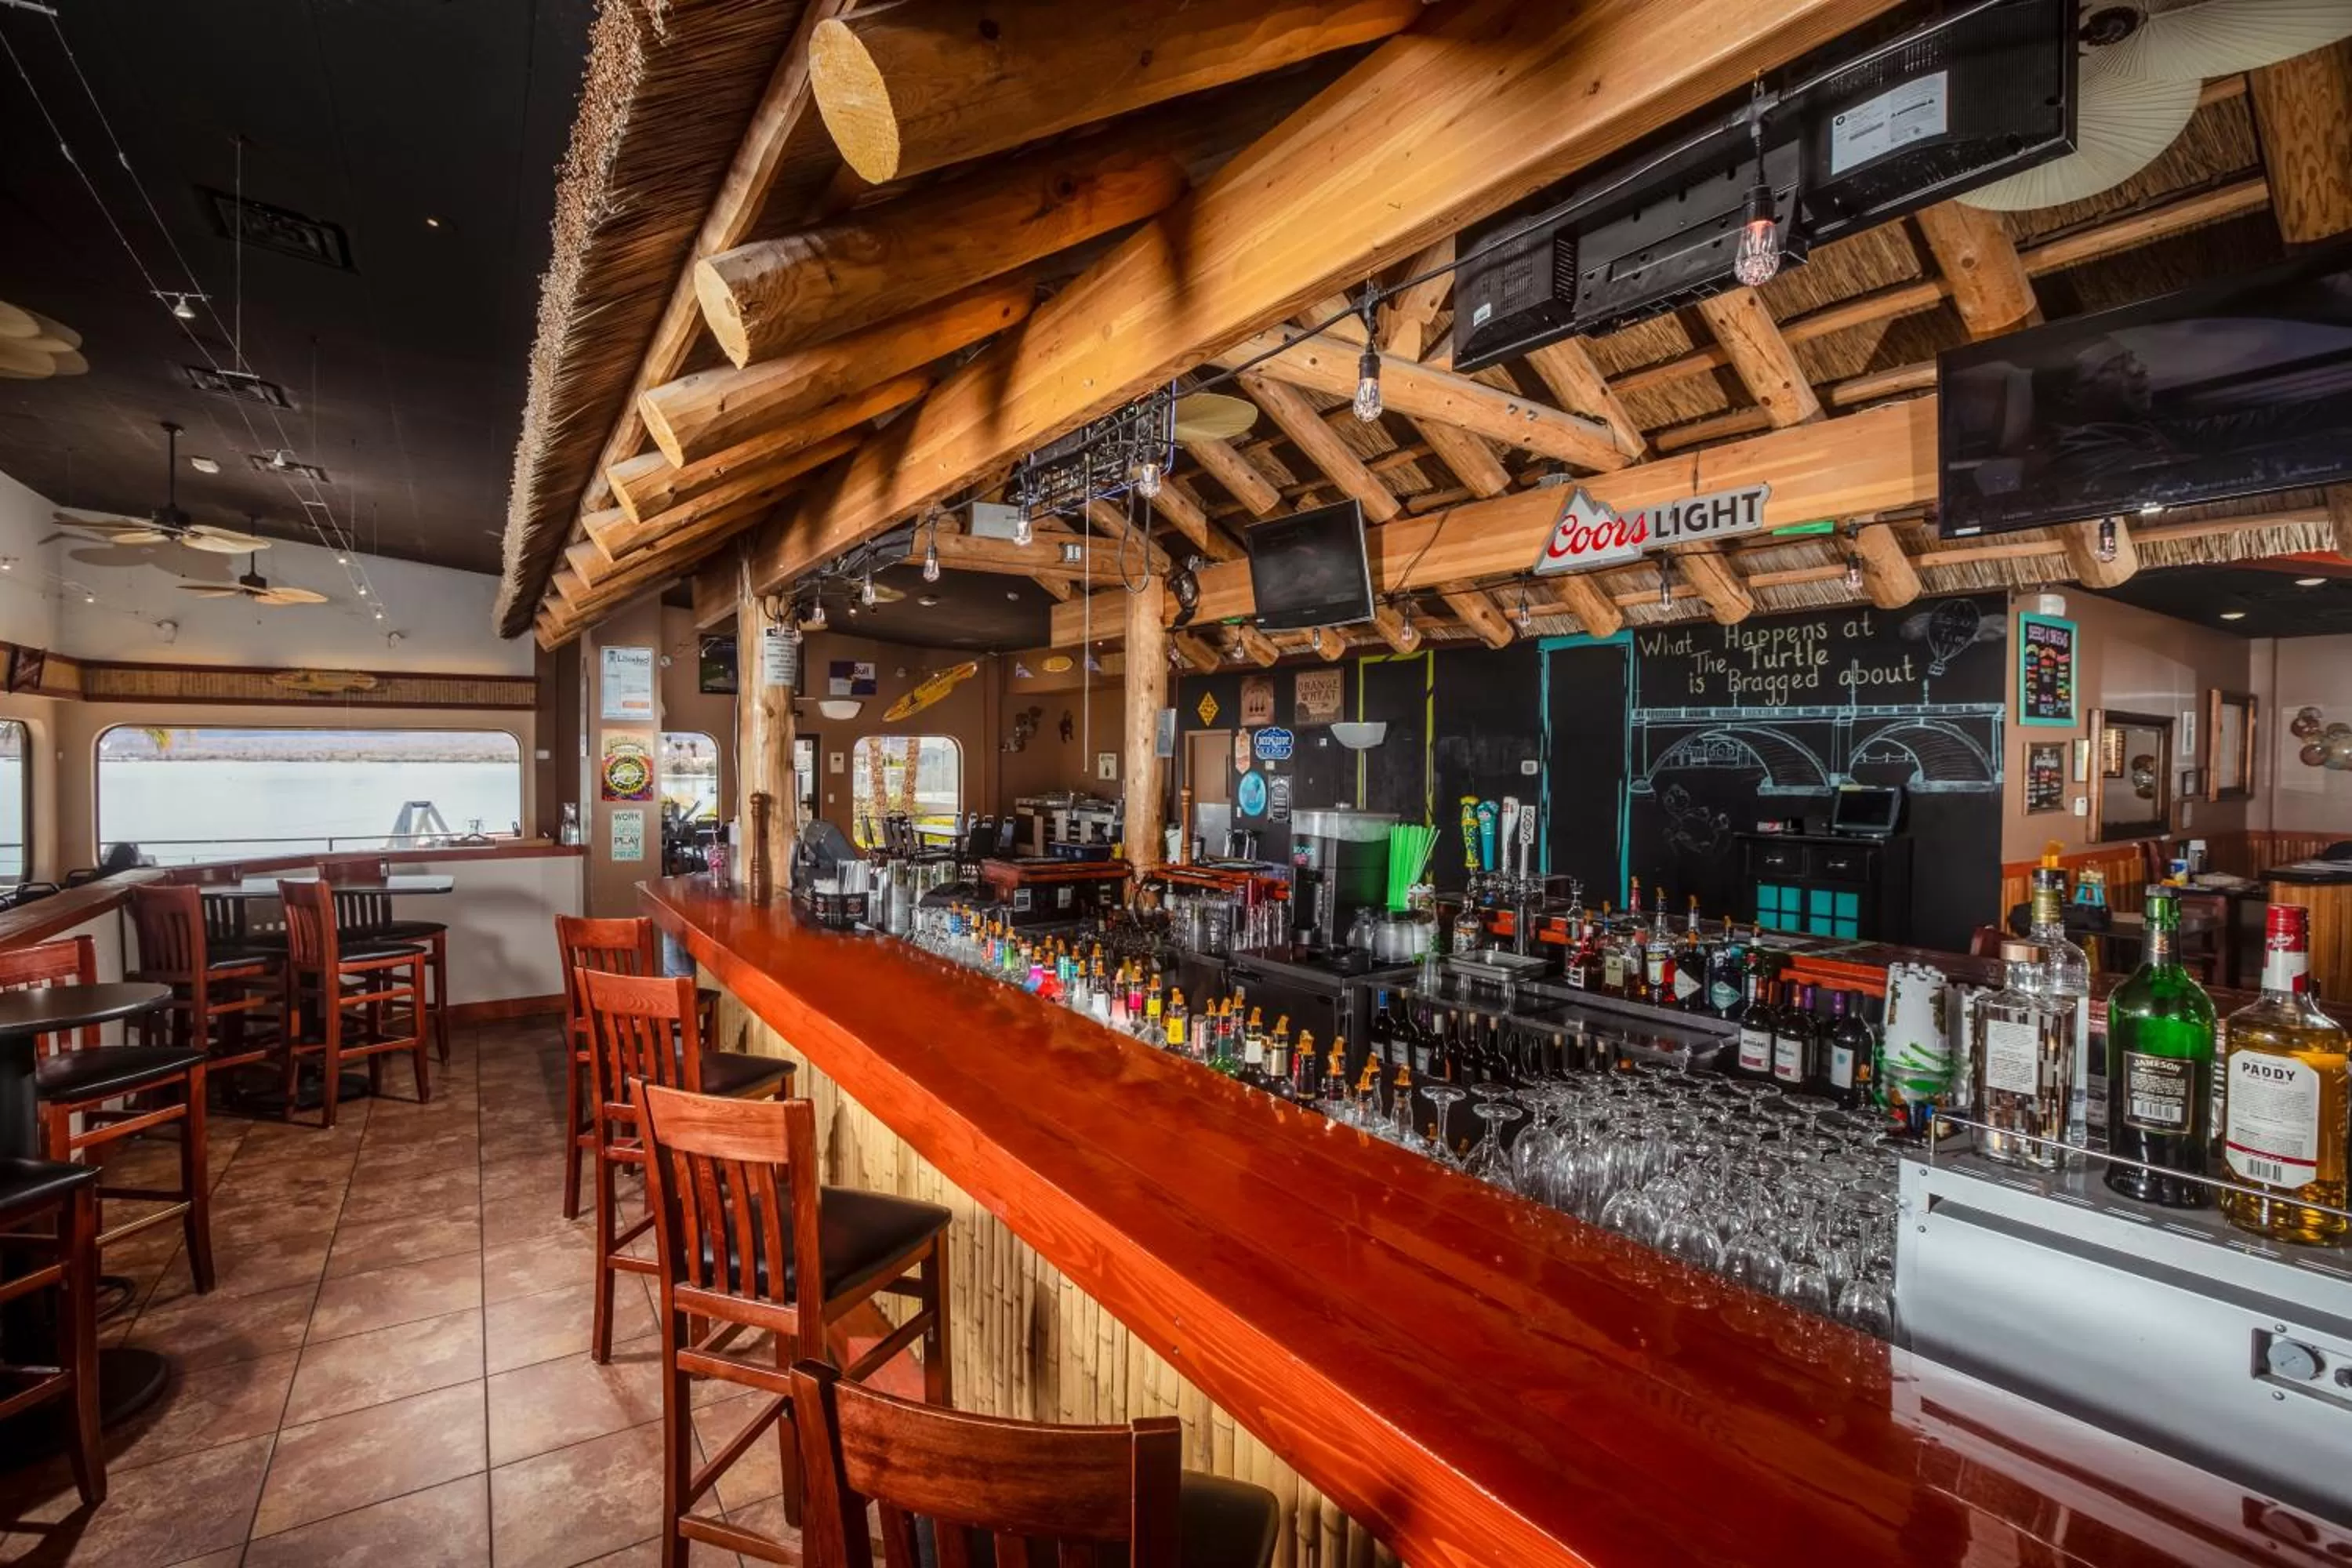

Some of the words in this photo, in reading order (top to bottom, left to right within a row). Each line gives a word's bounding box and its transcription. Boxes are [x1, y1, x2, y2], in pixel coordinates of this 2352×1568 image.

[1547, 512, 1650, 558] Coors
[1654, 491, 1762, 539] LIGHT
[1639, 630, 1694, 657] What
[1725, 622, 1828, 653] Happens
[1843, 611, 1875, 638] at
[1690, 648, 1726, 675] The
[1743, 639, 1830, 670] Turtle
[1298, 679, 1339, 691] ORANGE
[1689, 670, 1705, 695] is
[1726, 664, 1820, 706] Bragged
[1838, 654, 1917, 685] about
[614, 812, 641, 821] WORK
[614, 837, 641, 848] PLAY
[2241, 1062, 2296, 1081] PADDY
